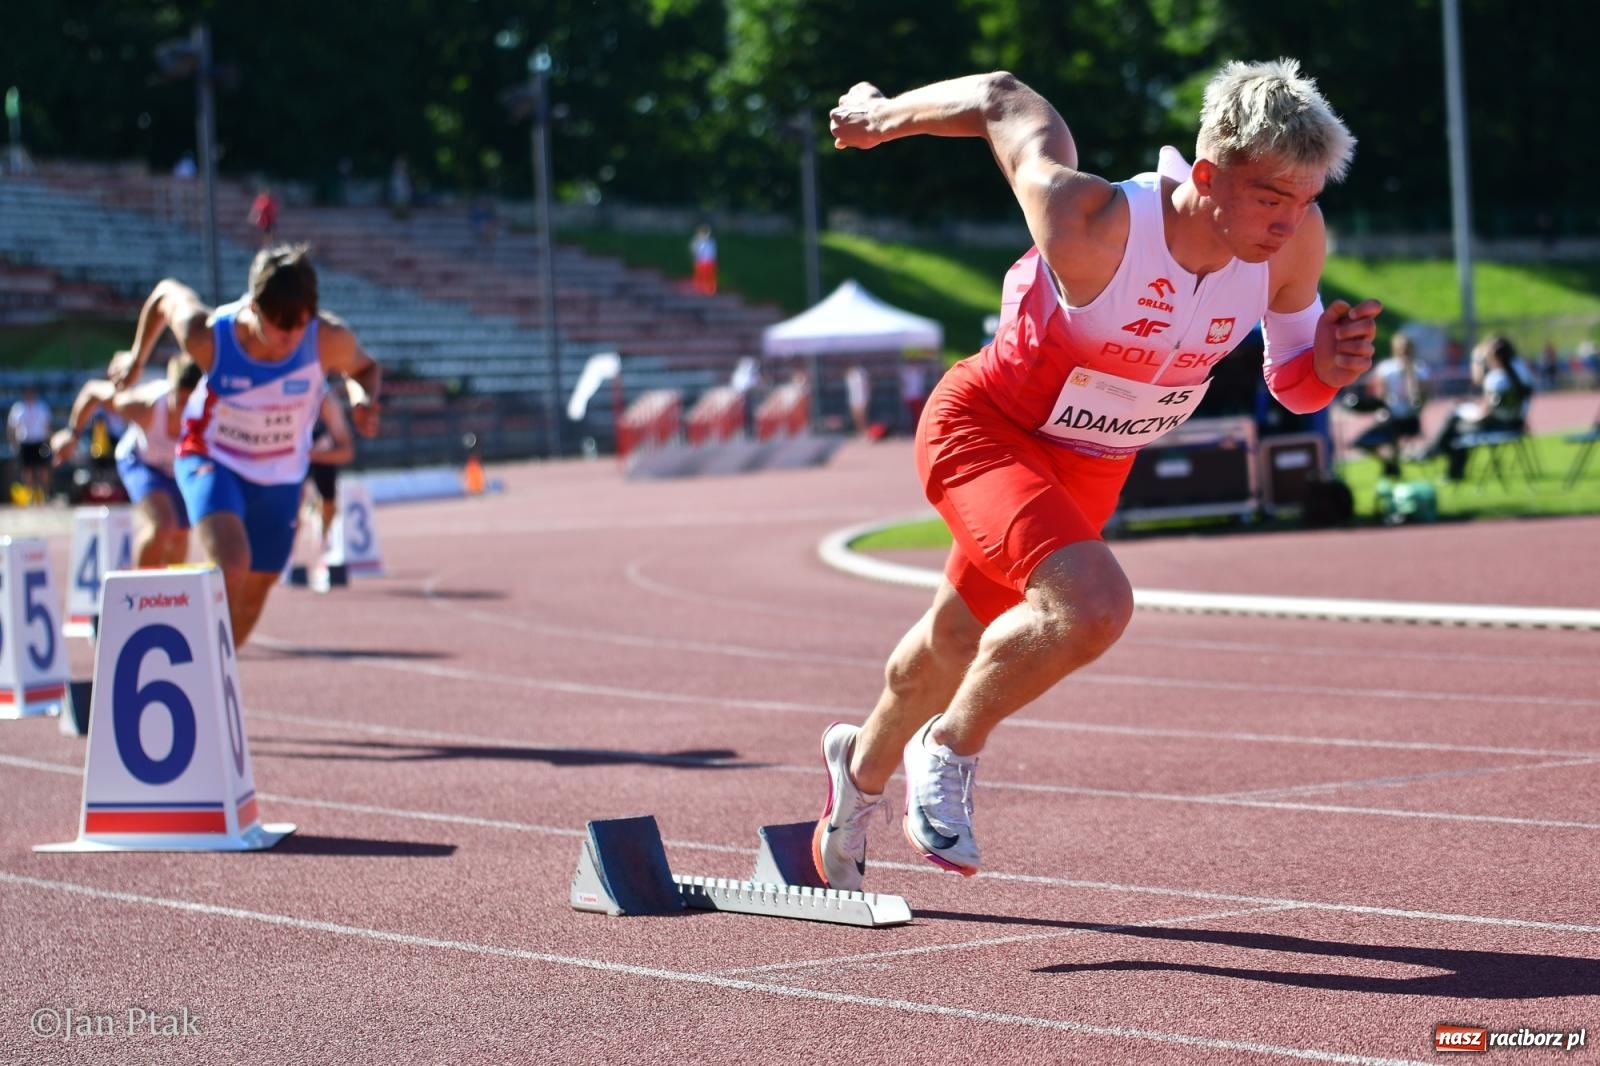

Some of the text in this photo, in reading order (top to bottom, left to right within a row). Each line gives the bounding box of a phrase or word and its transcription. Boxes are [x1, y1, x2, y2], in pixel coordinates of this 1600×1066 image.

[1137, 297, 1174, 313] ORLEN
[1121, 318, 1171, 337] 4F
[1158, 389, 1194, 405] 45
[1053, 405, 1187, 435] ADAMCZYK
[347, 501, 372, 556] 3
[76, 533, 101, 604] 4
[139, 591, 190, 612] polanik
[24, 570, 56, 672] 5
[112, 623, 197, 787] 6
